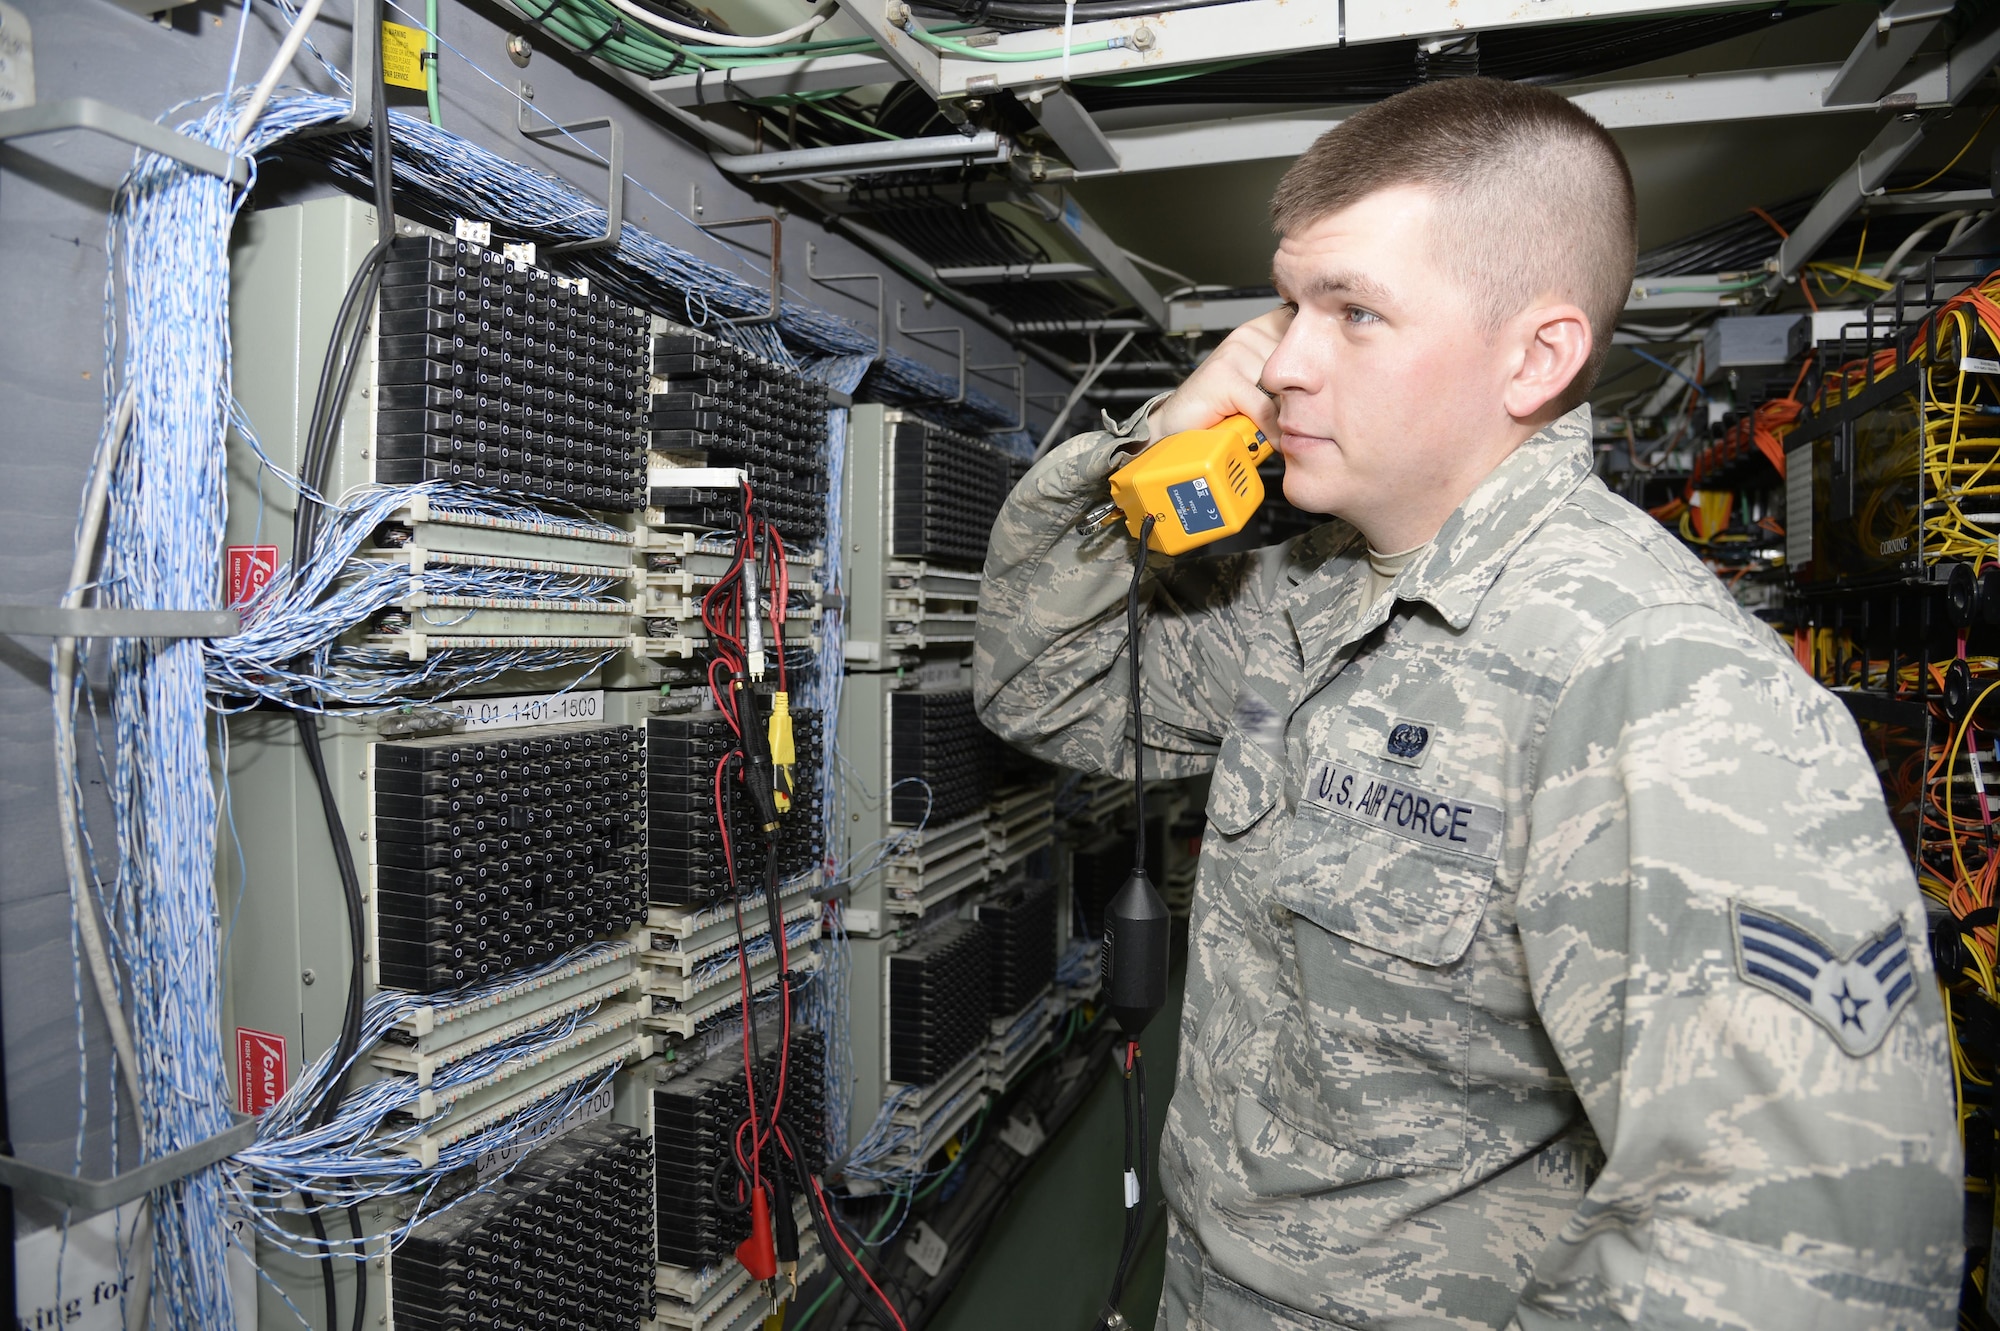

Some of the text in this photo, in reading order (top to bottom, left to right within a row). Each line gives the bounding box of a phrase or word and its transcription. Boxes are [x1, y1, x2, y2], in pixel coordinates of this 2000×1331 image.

[1879, 536, 1908, 556] CORNING
[234, 579, 241, 590] OF
[1318, 767, 1472, 843] U.S. AIR FORCE
[246, 1061, 253, 1071] OF
[93, 1275, 134, 1305] for
